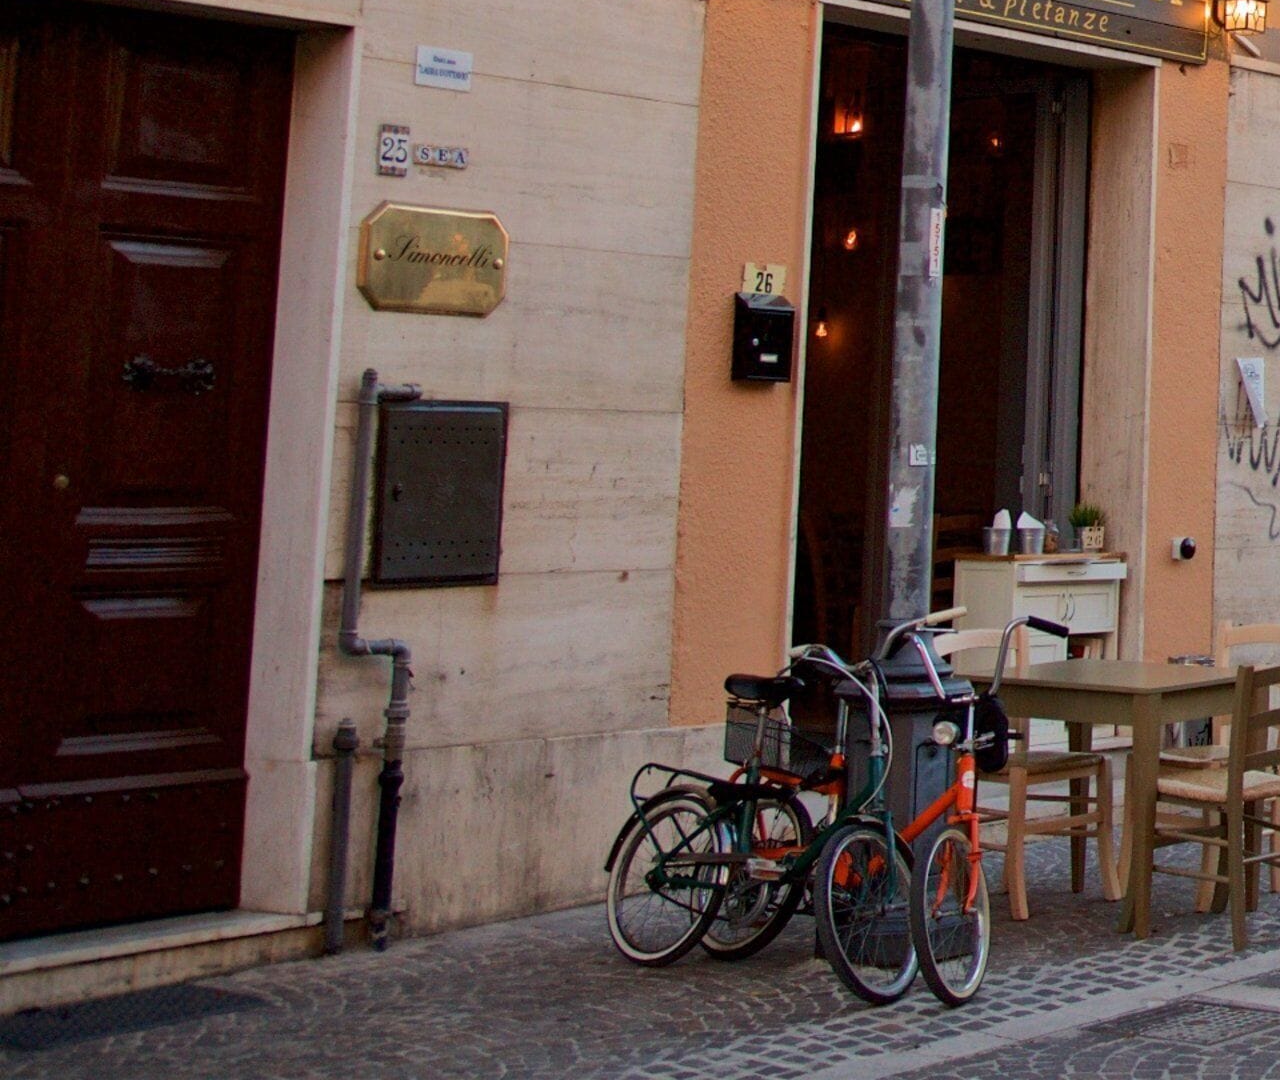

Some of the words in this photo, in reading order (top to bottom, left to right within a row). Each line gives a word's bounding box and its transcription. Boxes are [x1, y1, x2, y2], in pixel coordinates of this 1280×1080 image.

[381, 136, 408, 163] 25
[420, 147, 465, 164] SEA
[388, 235, 494, 269] Simoncelli
[755, 271, 773, 294] 26
